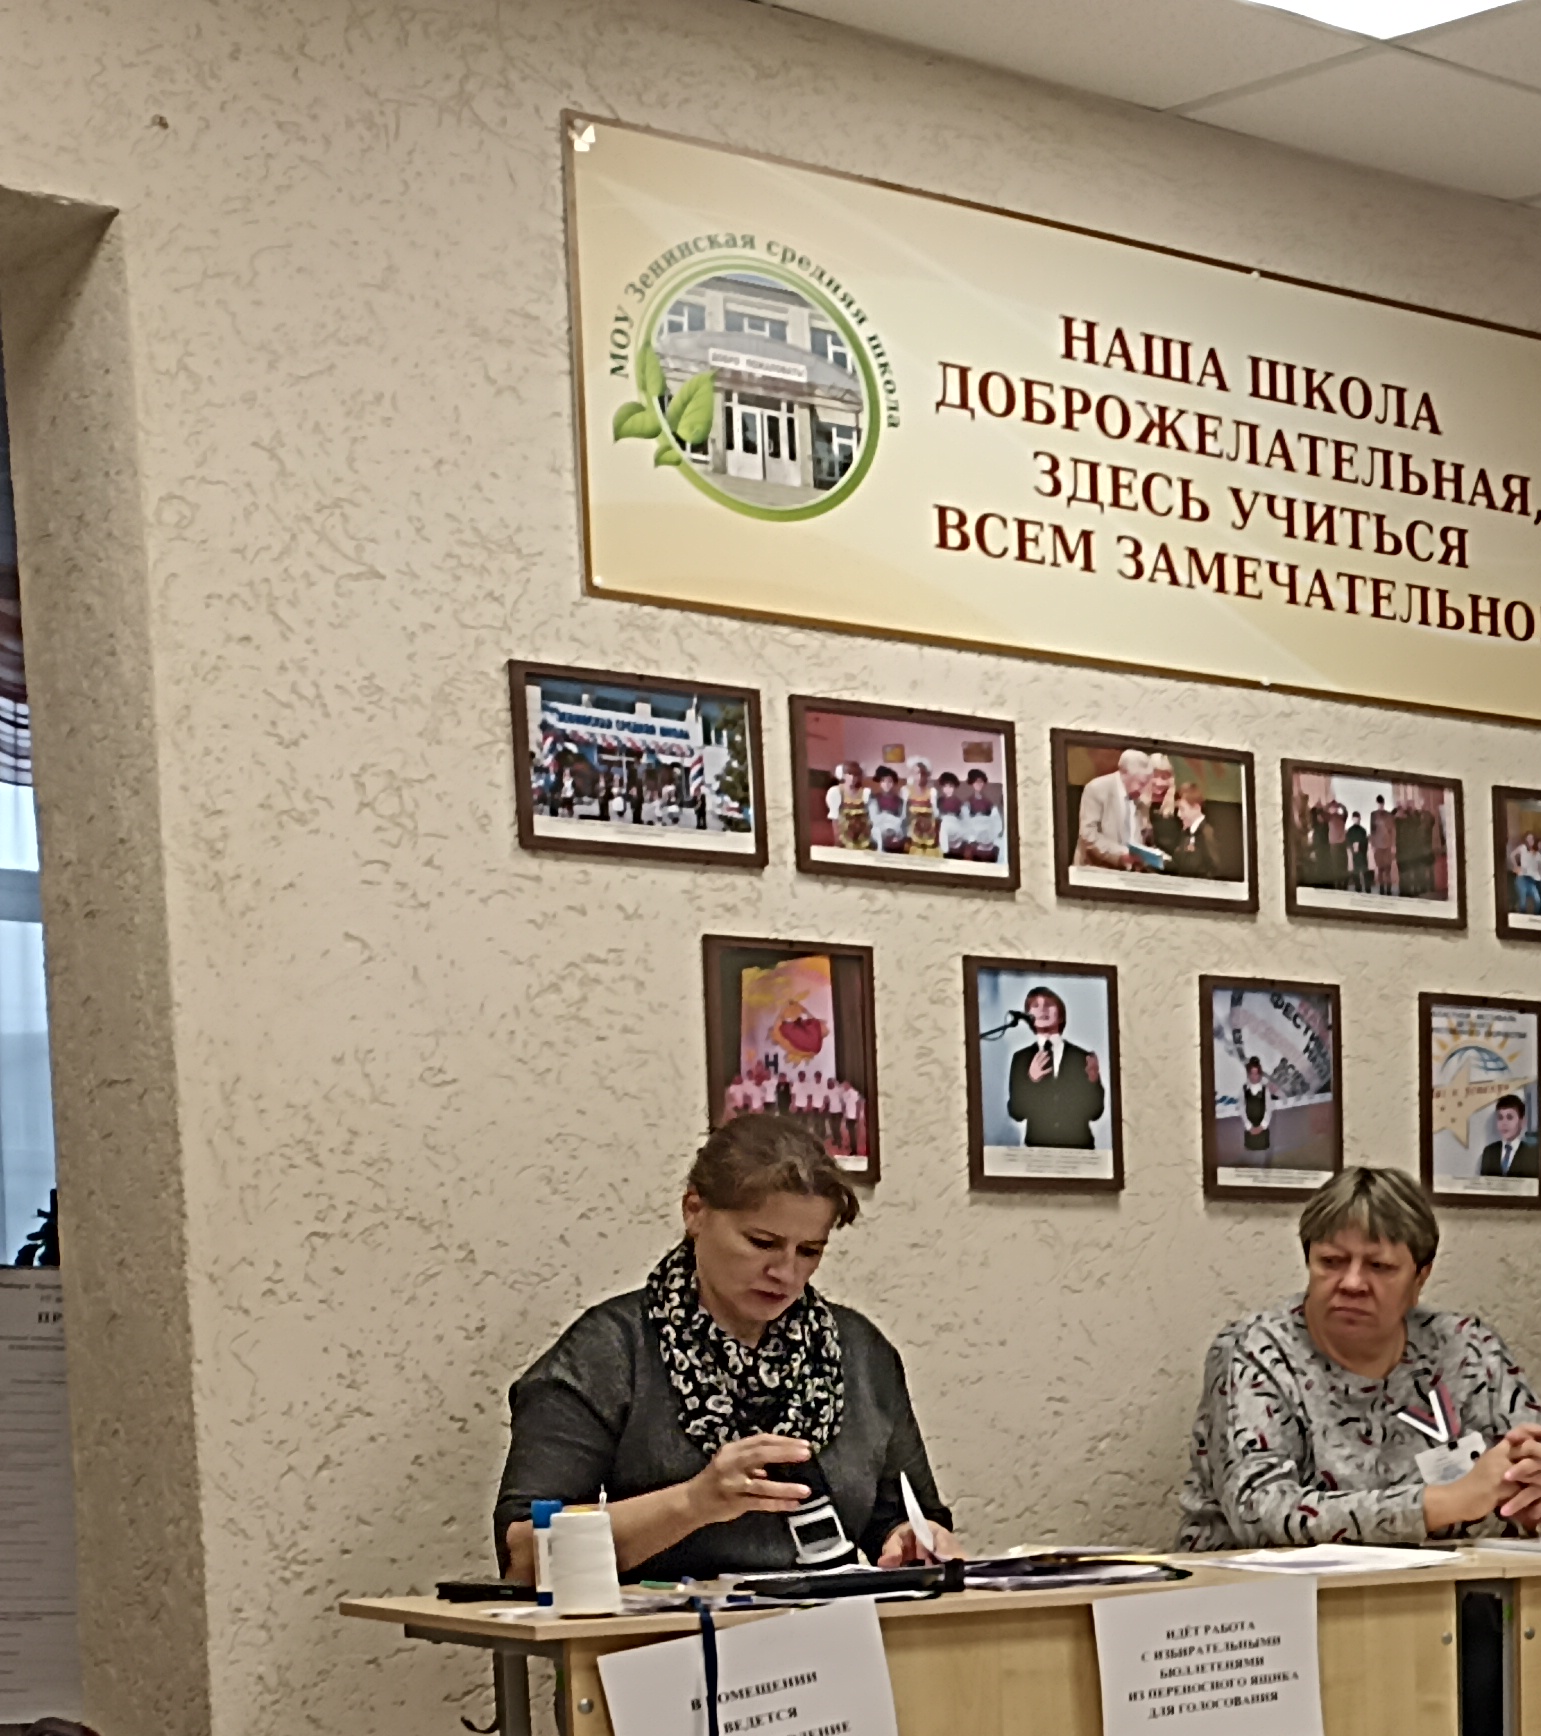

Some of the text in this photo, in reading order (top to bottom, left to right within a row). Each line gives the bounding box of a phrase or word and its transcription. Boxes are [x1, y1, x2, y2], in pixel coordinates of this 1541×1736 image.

[610, 305, 635, 379] МОУ
[766, 236, 869, 326] средняя
[866, 334, 900, 428] школа
[1060, 315, 1443, 435] НАША ШКОЛА
[1033, 451, 1471, 569] ЗДЕСЬ УЧИТЬСЯ
[933, 504, 1097, 573] ВСЕМ
[1165, 1621, 1256, 1641] ИДЁТ РАБОТА
[1141, 1635, 1281, 1662] С ИЗБИРАТЕЛЬНЫМИ
[1160, 1656, 1265, 1679] БЮЛЛЕТЕНЯМИ
[691, 1671, 818, 1711] В ОМЕЩЕНИИ
[1128, 1671, 1299, 1702] ИЗ ПЕРЕНОСНОГО ЯЩИКА
[723, 1706, 798, 1734] ВЕДЕТСЯ
[1148, 1691, 1278, 1720] ДЛЯ ГОЛОСОВАНИЯ
